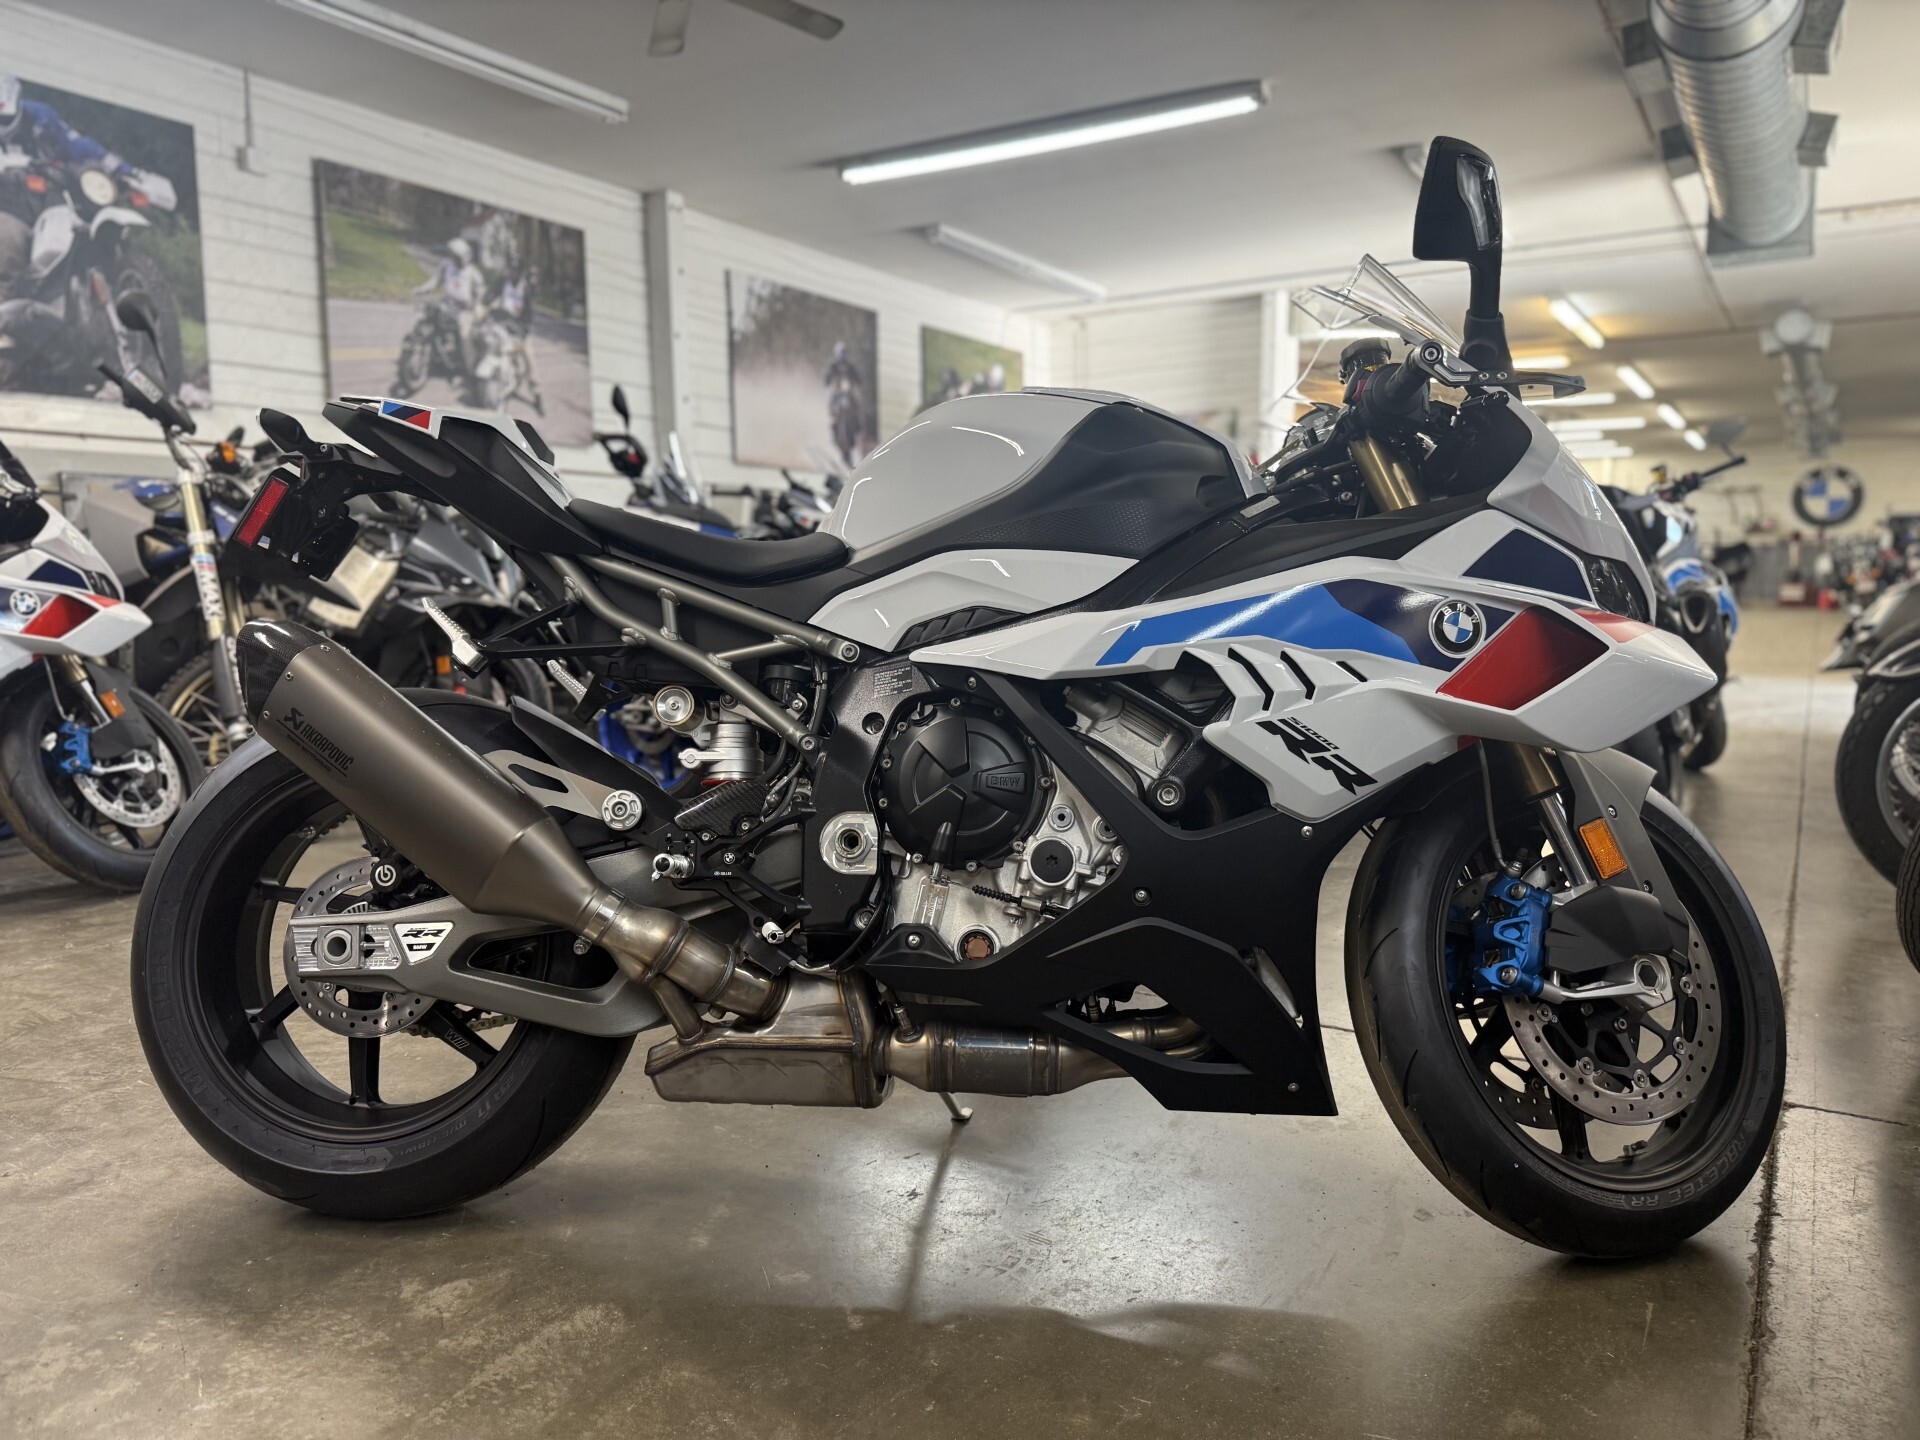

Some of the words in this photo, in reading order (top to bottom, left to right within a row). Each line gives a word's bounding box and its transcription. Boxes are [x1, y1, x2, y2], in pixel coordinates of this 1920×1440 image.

[1441, 603, 1480, 624] BMW
[1287, 716, 1340, 750] S1000
[1255, 718, 1378, 796] RR
[990, 775, 1021, 787] BMW
[401, 928, 447, 938] RR
[1631, 1194, 1659, 1207] RR
